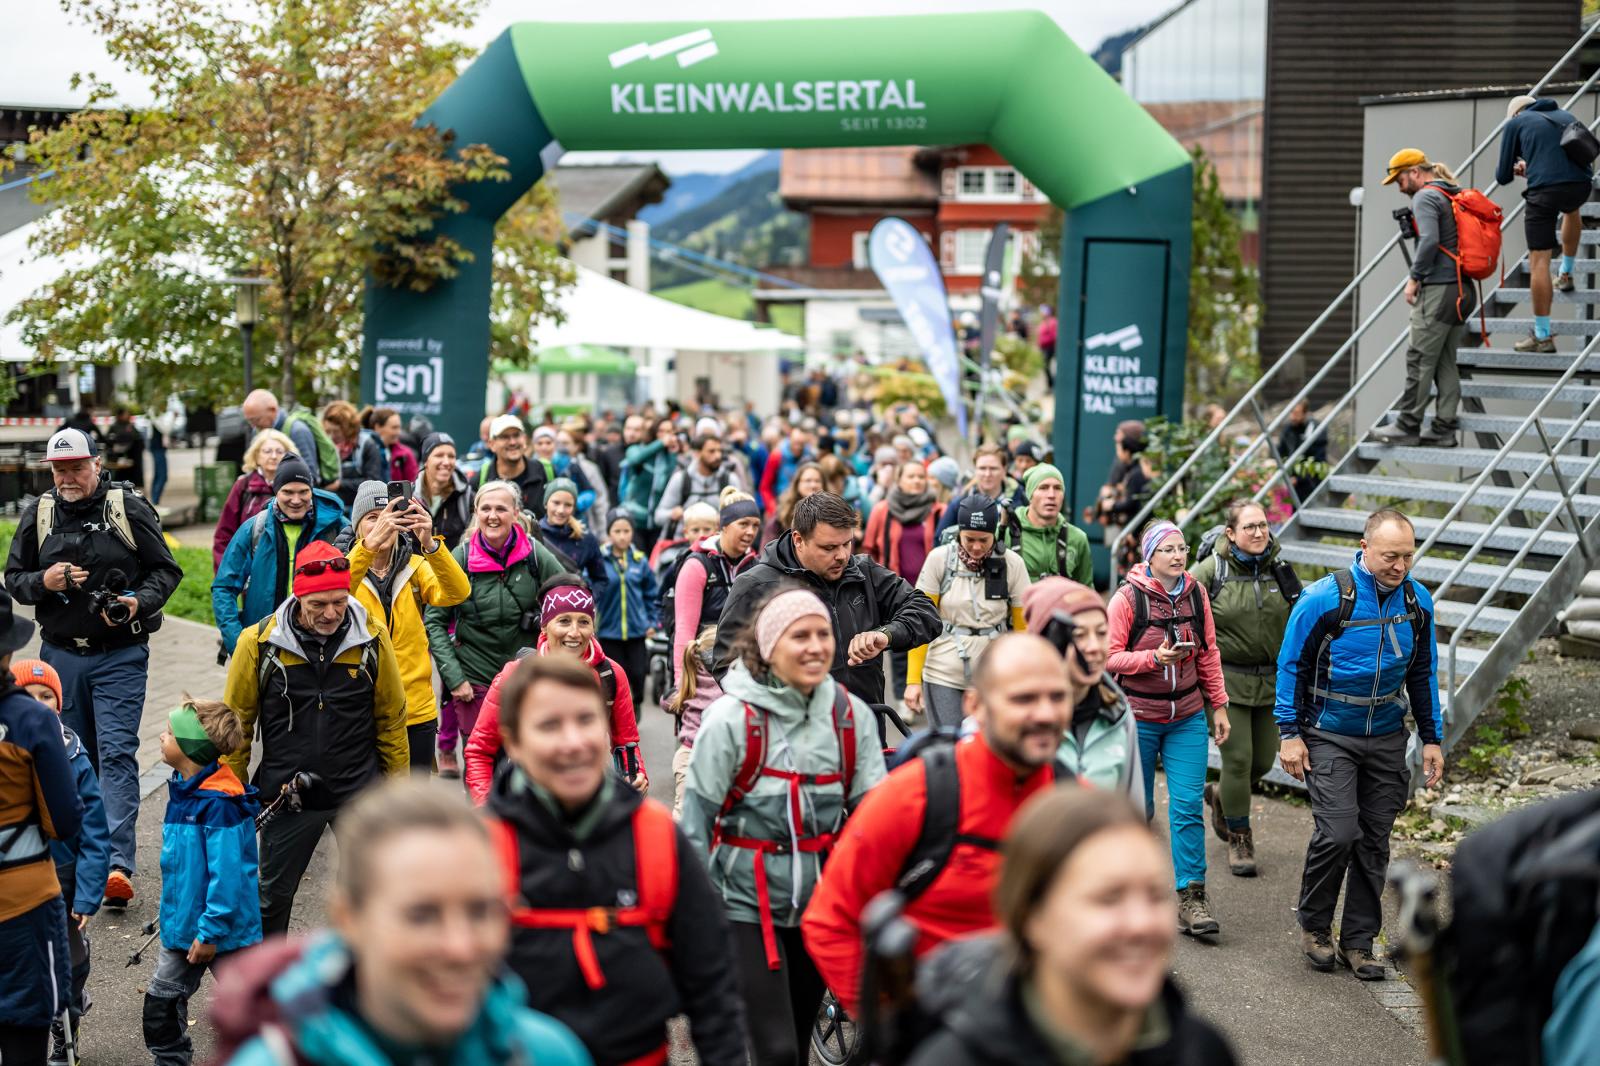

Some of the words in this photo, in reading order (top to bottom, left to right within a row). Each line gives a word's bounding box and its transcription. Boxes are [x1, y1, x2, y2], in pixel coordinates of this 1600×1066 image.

[611, 79, 926, 113] KLEINWALSERTAL
[840, 118, 879, 131] SEIT
[886, 117, 928, 130] 1302
[1085, 355, 1140, 374] KLEIN
[375, 355, 443, 402] [sn]
[1083, 374, 1158, 395] WALSER
[1083, 393, 1116, 414] TAL
